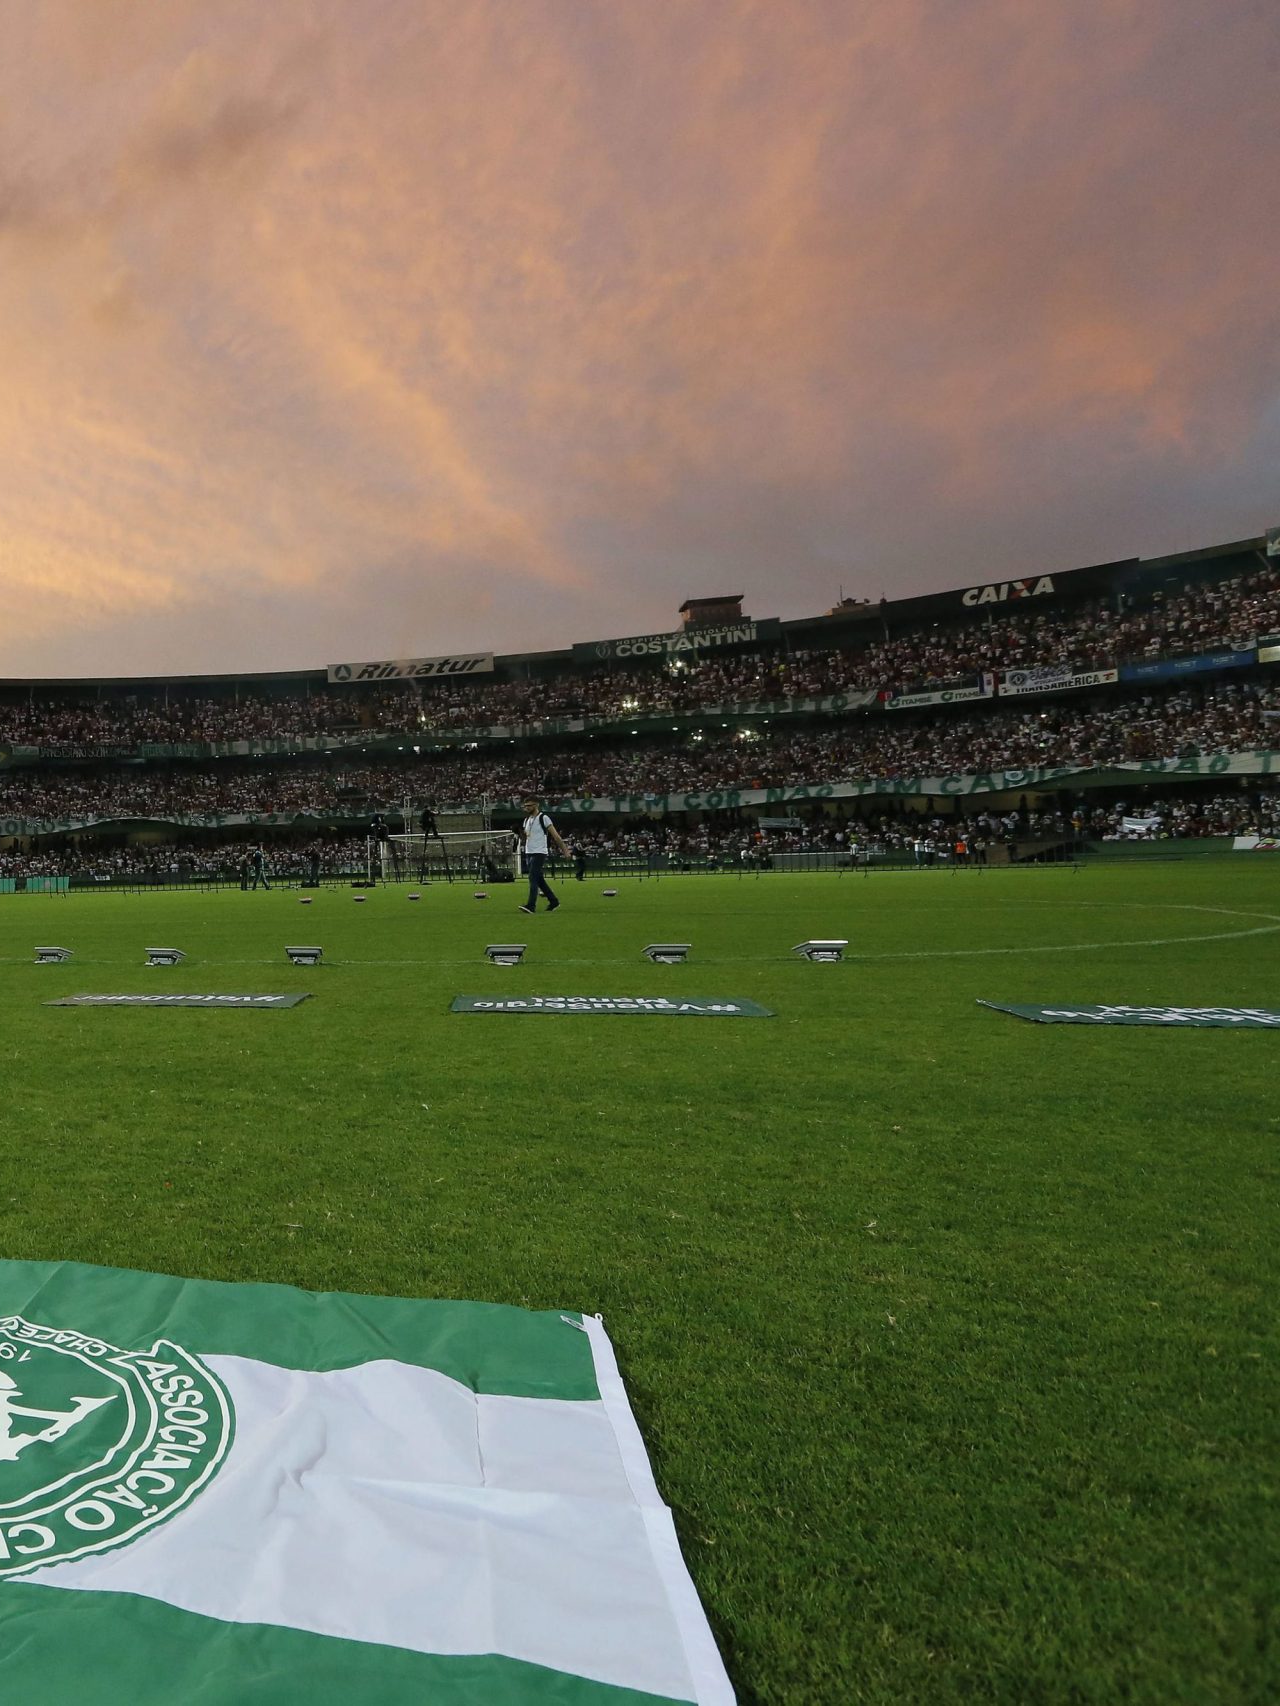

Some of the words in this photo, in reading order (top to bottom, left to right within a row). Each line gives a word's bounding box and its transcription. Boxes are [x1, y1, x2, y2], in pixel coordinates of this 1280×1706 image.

[962, 576, 1055, 606] CAIXA
[615, 628, 757, 657] COSTANTINI
[616, 635, 667, 645] HOSPITAL
[356, 658, 486, 679] Rimatur
[64, 1359, 210, 1532] ASSOCIAÇÃO
